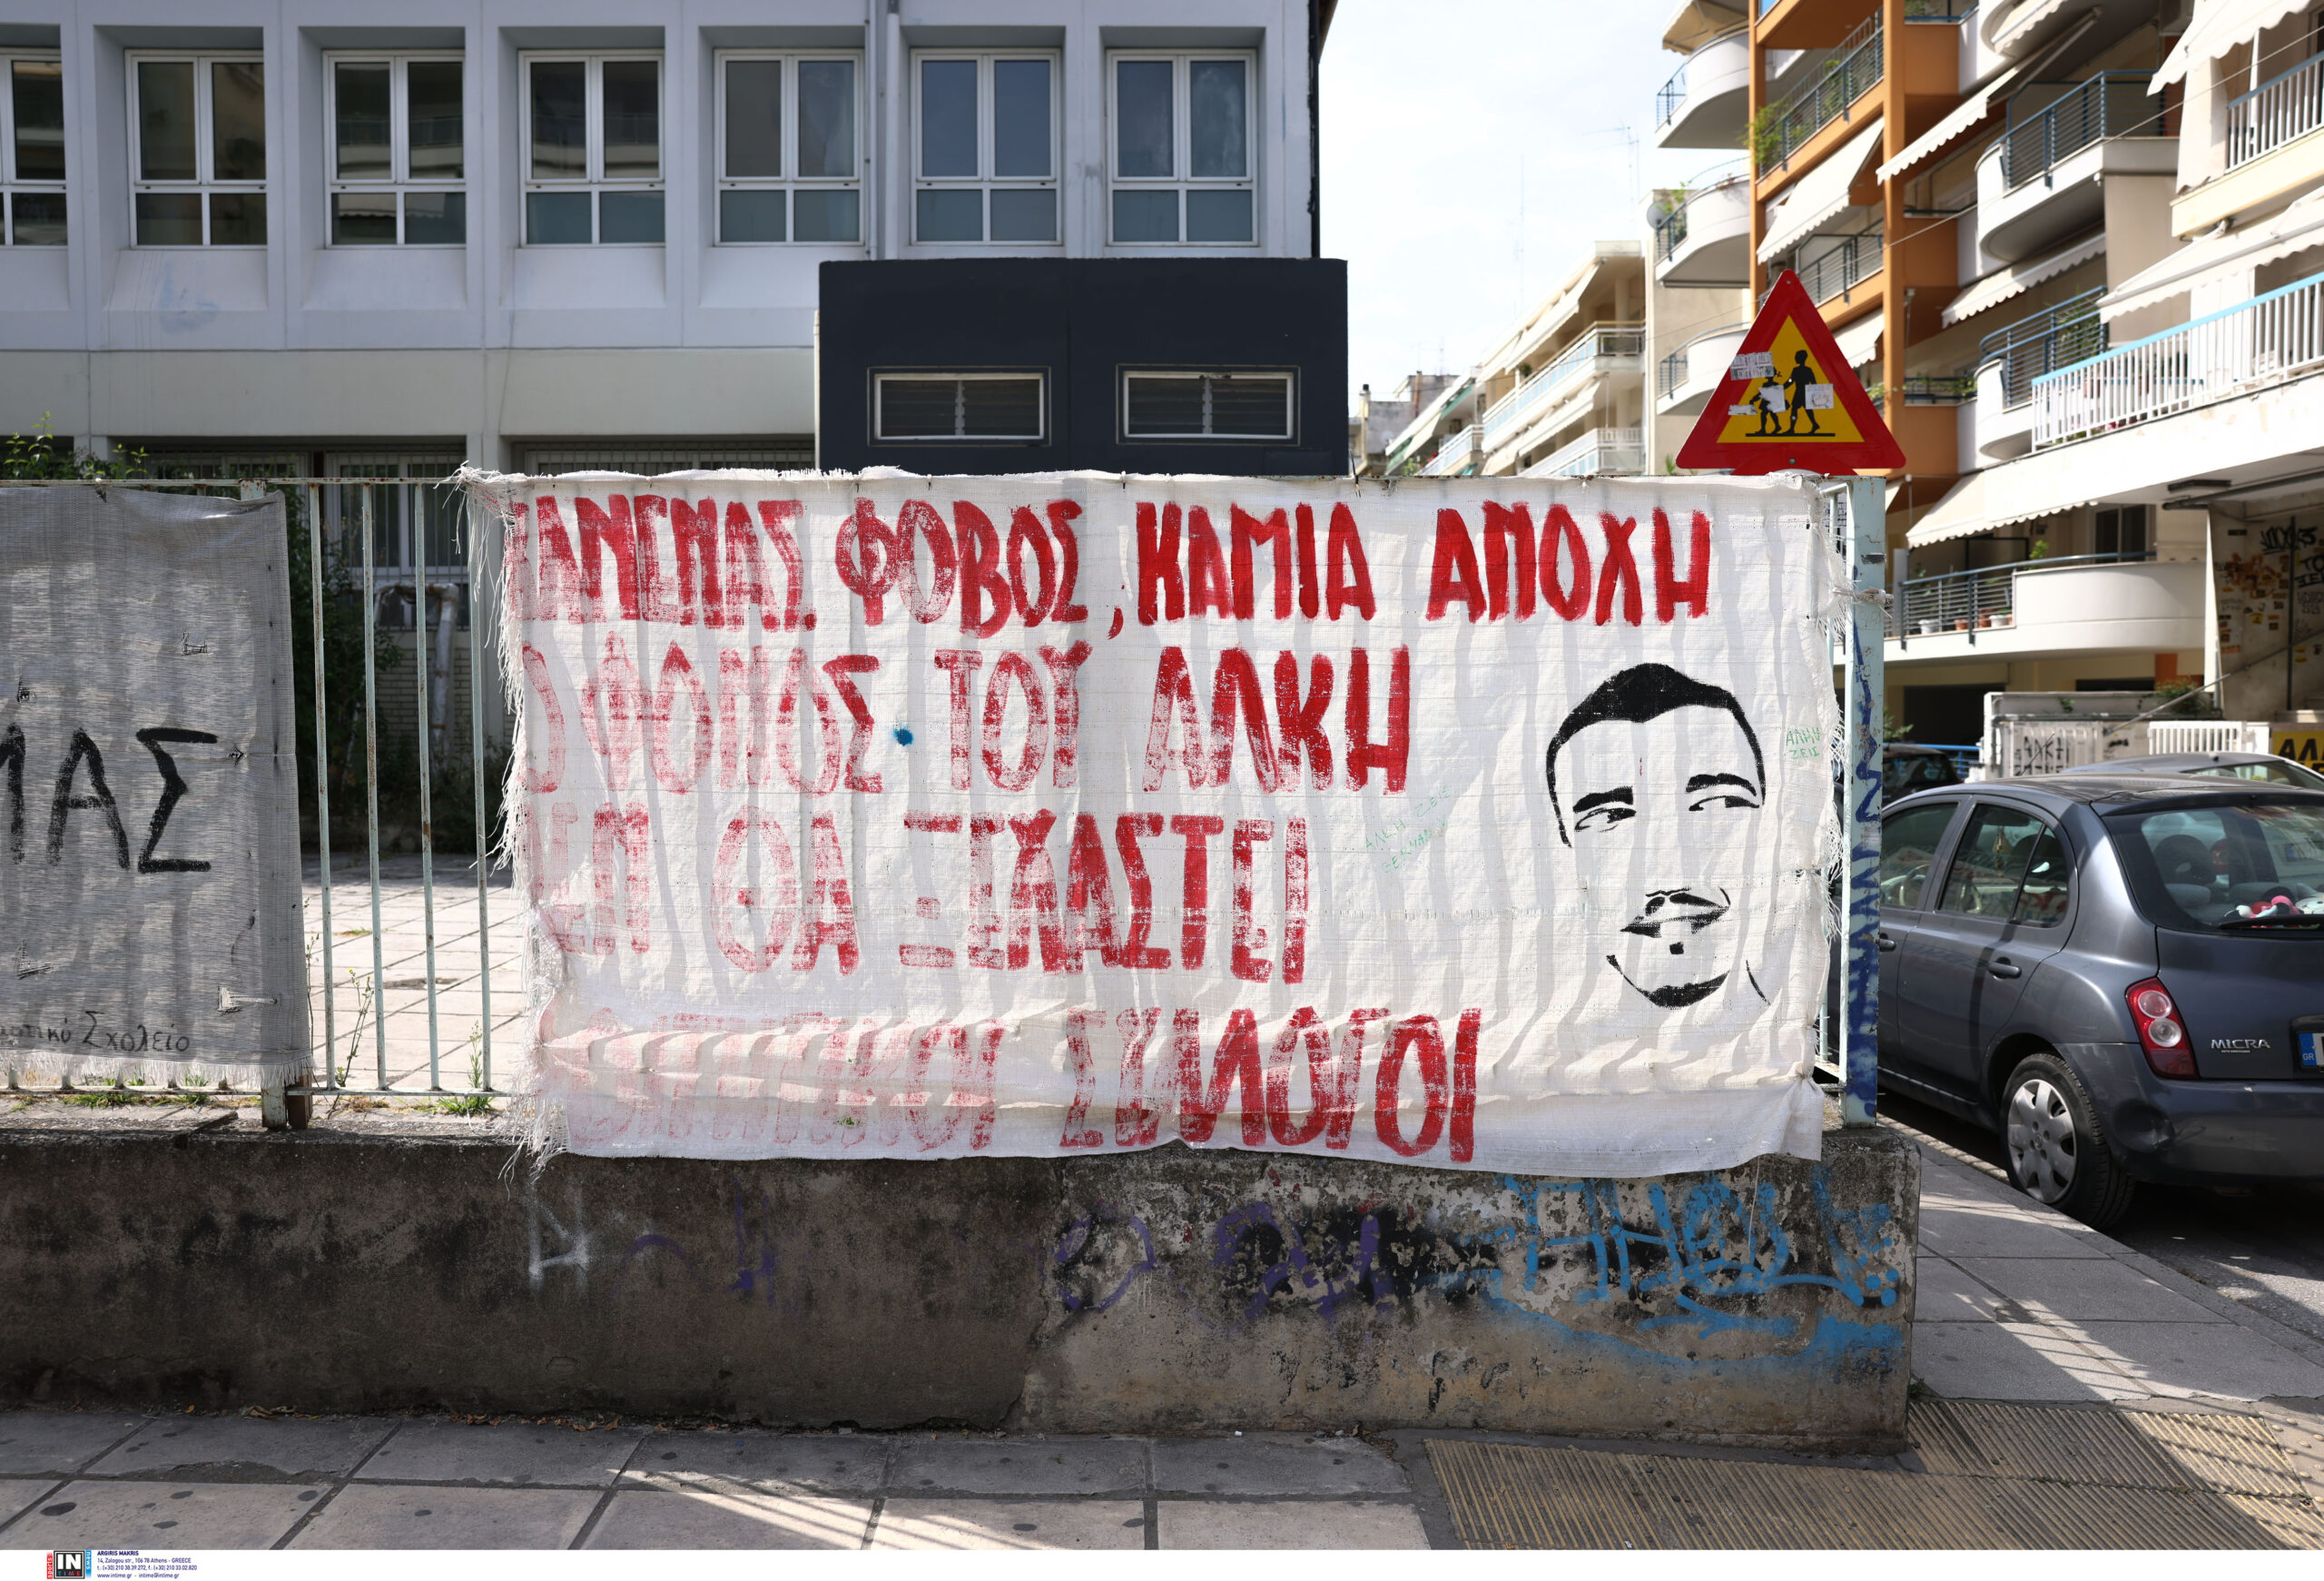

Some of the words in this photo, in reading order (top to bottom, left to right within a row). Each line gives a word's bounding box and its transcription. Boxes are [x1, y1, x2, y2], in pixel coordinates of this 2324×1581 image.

[1136, 500, 1375, 626] ΚΑΜΙΑ
[1425, 499, 1710, 627] ΑΠΟΧΗ
[581, 631, 882, 798] ΦΟΝΟΣ
[933, 639, 1093, 793] ΤΟΥ
[1142, 644, 1410, 795] ΑΛΚΗ
[710, 805, 861, 976] ΘΑ
[899, 808, 1308, 984] ΞΕΧΑΣΤΕΙ
[83, 1010, 190, 1052] Σχολείο
[1059, 1006, 1482, 1162] ΣΥΛΛΟΓΟΙ
[2211, 1039, 2271, 1049] MICRA
[2302, 1052, 2315, 1061] GR
